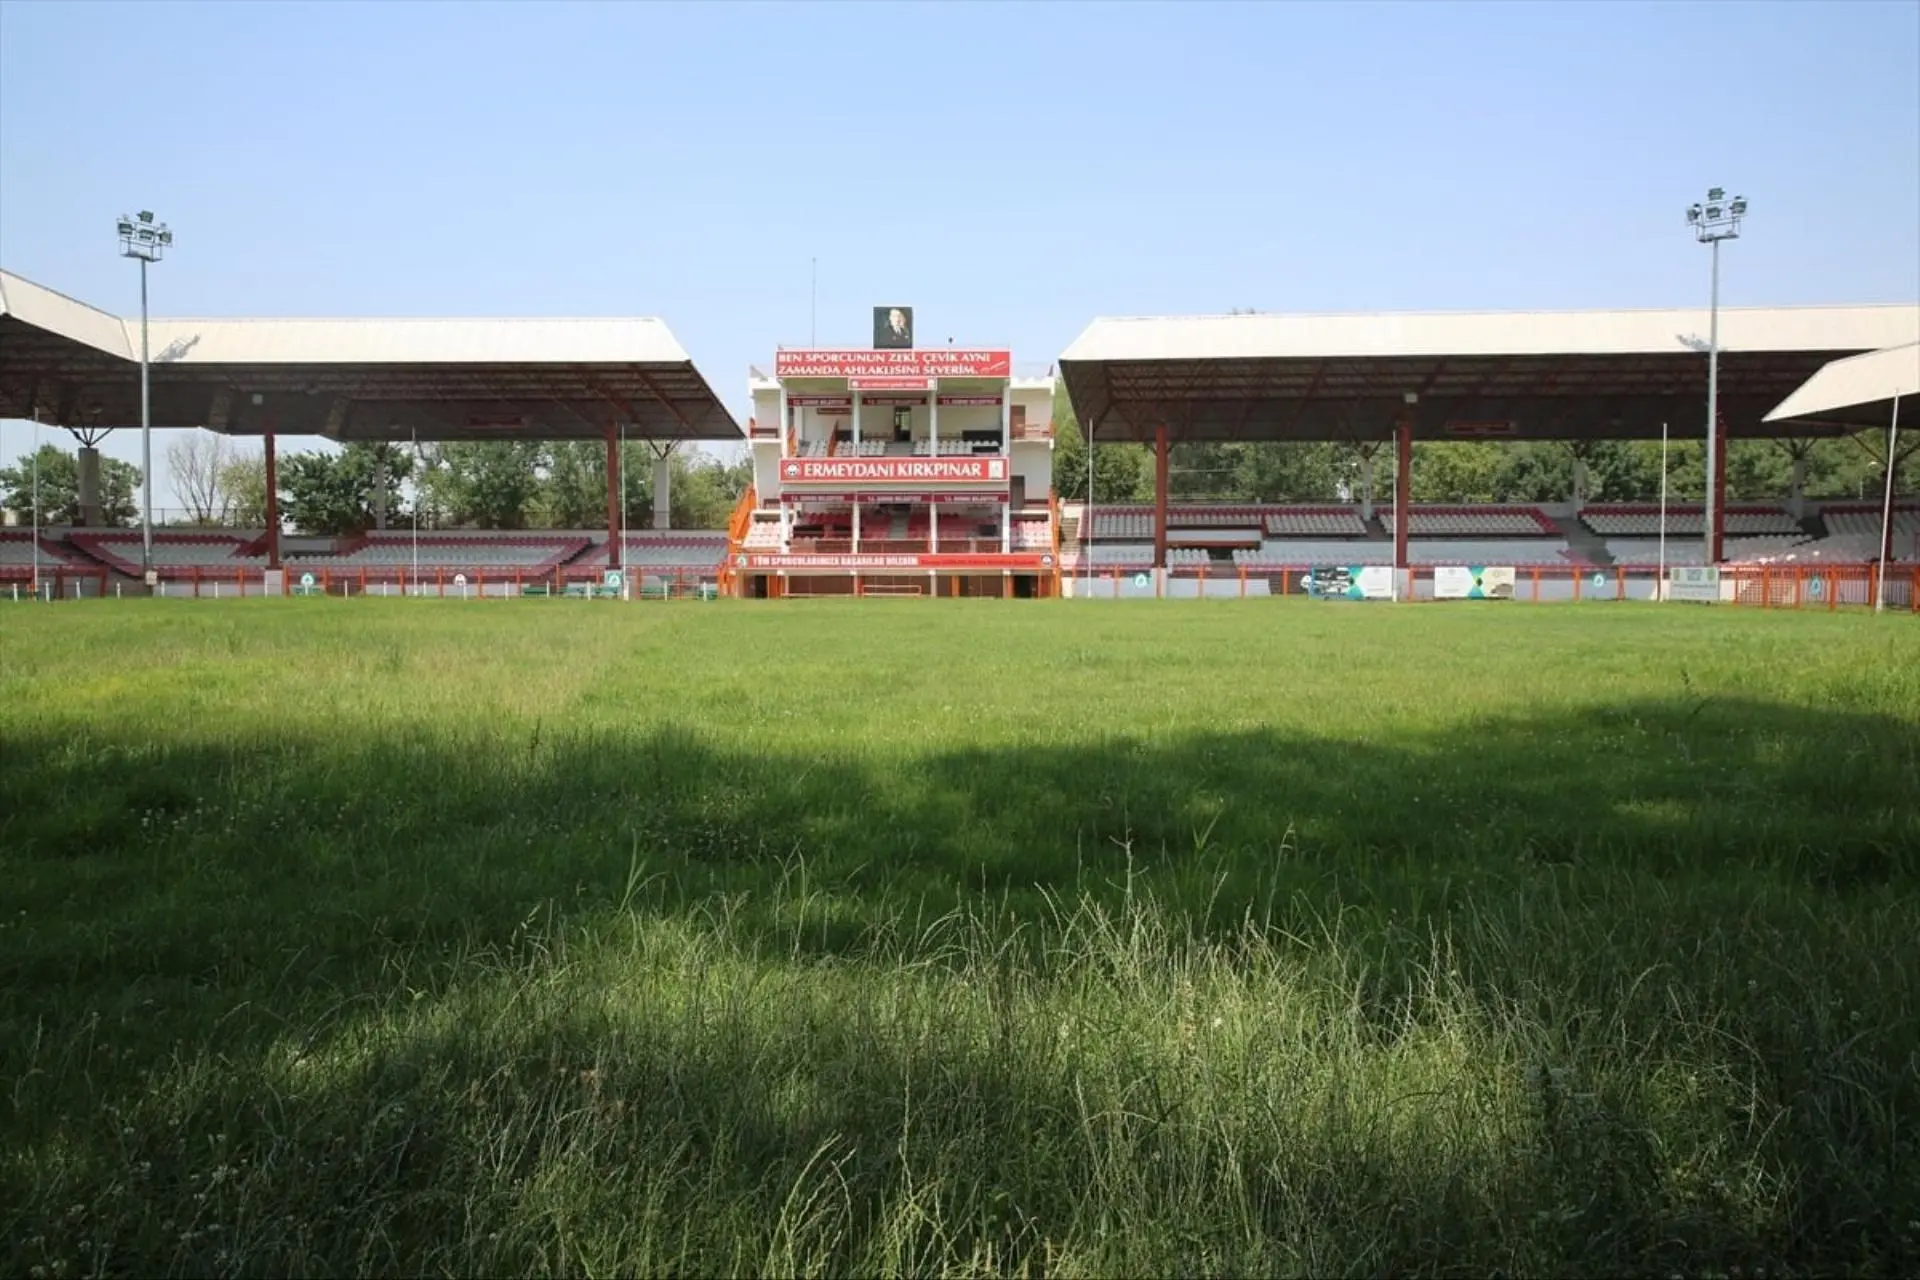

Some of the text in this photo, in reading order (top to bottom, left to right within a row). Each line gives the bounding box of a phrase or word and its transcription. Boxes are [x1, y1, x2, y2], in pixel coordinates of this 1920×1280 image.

[778, 352, 801, 362] BEN
[805, 352, 885, 362] SPORCUNUN
[922, 350, 957, 364] ÇEVİK
[778, 365, 841, 375] ZAMANDA
[803, 463, 982, 477] ERMEYDANI KIRKPINAR
